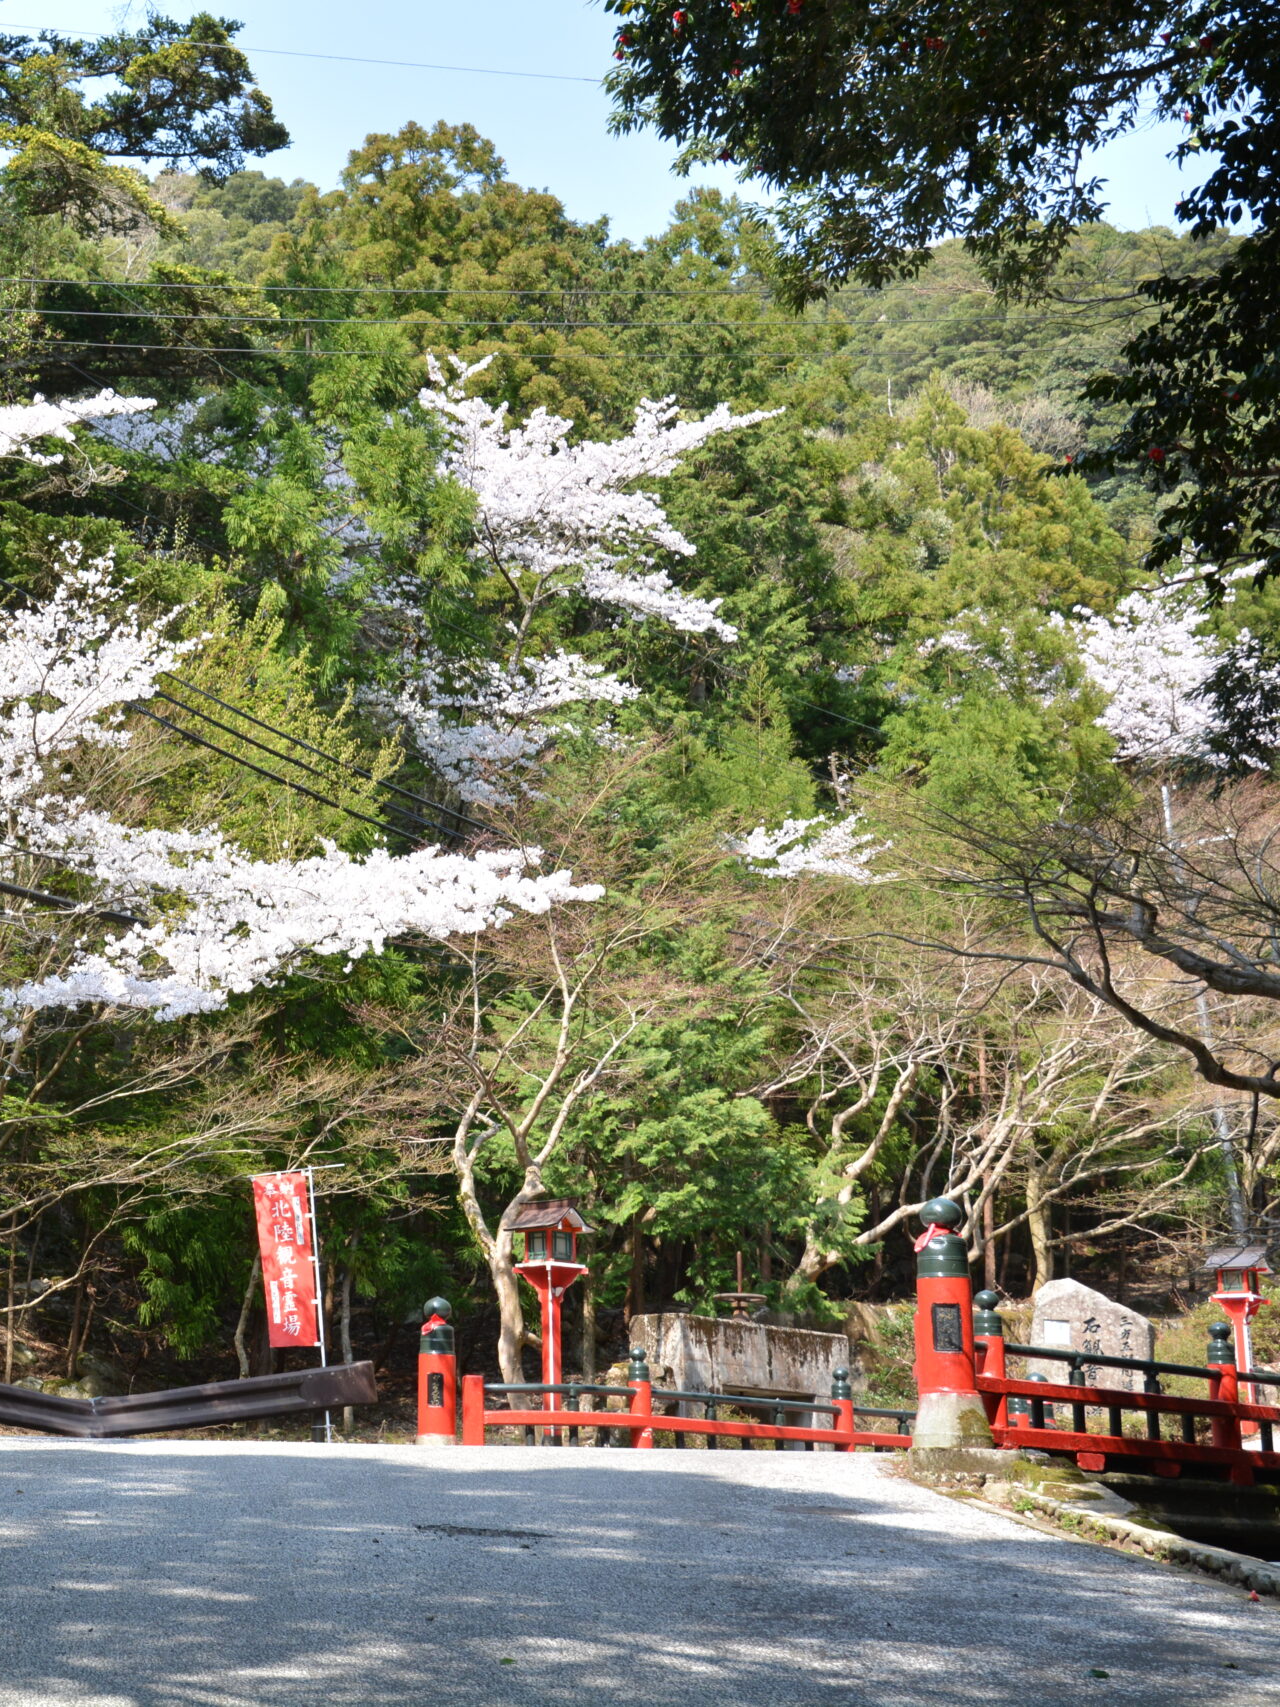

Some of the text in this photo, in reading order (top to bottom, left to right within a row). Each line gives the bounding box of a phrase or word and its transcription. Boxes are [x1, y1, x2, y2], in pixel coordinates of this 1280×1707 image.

[272, 1201, 302, 1336] 北陸観音霊場
